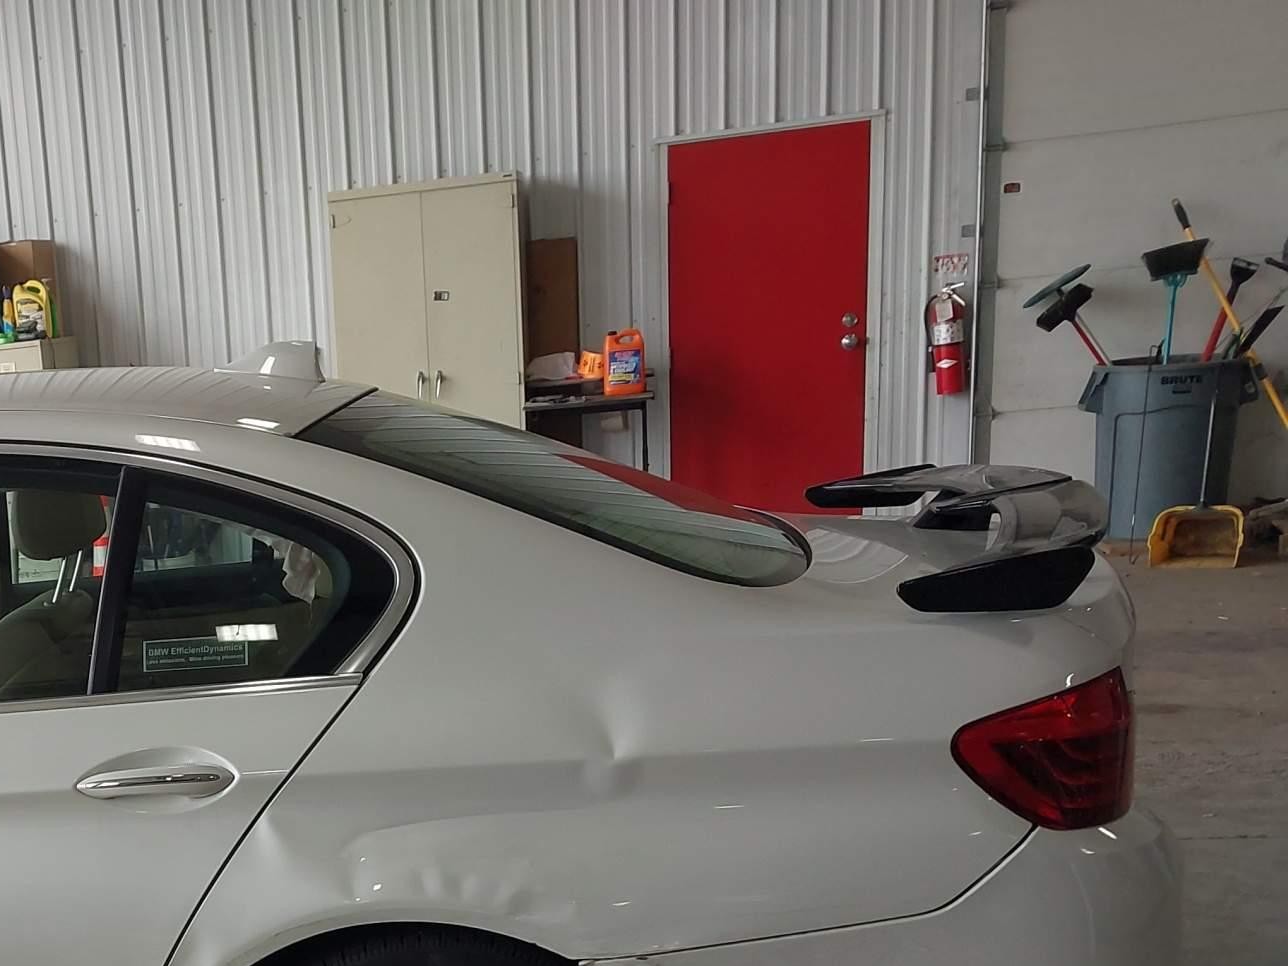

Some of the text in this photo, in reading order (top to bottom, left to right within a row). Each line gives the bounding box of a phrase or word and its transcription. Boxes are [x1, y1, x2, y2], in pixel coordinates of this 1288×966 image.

[1160, 375, 1203, 385] BRUTE
[148, 644, 244, 657] BMW EfficientDynamics
